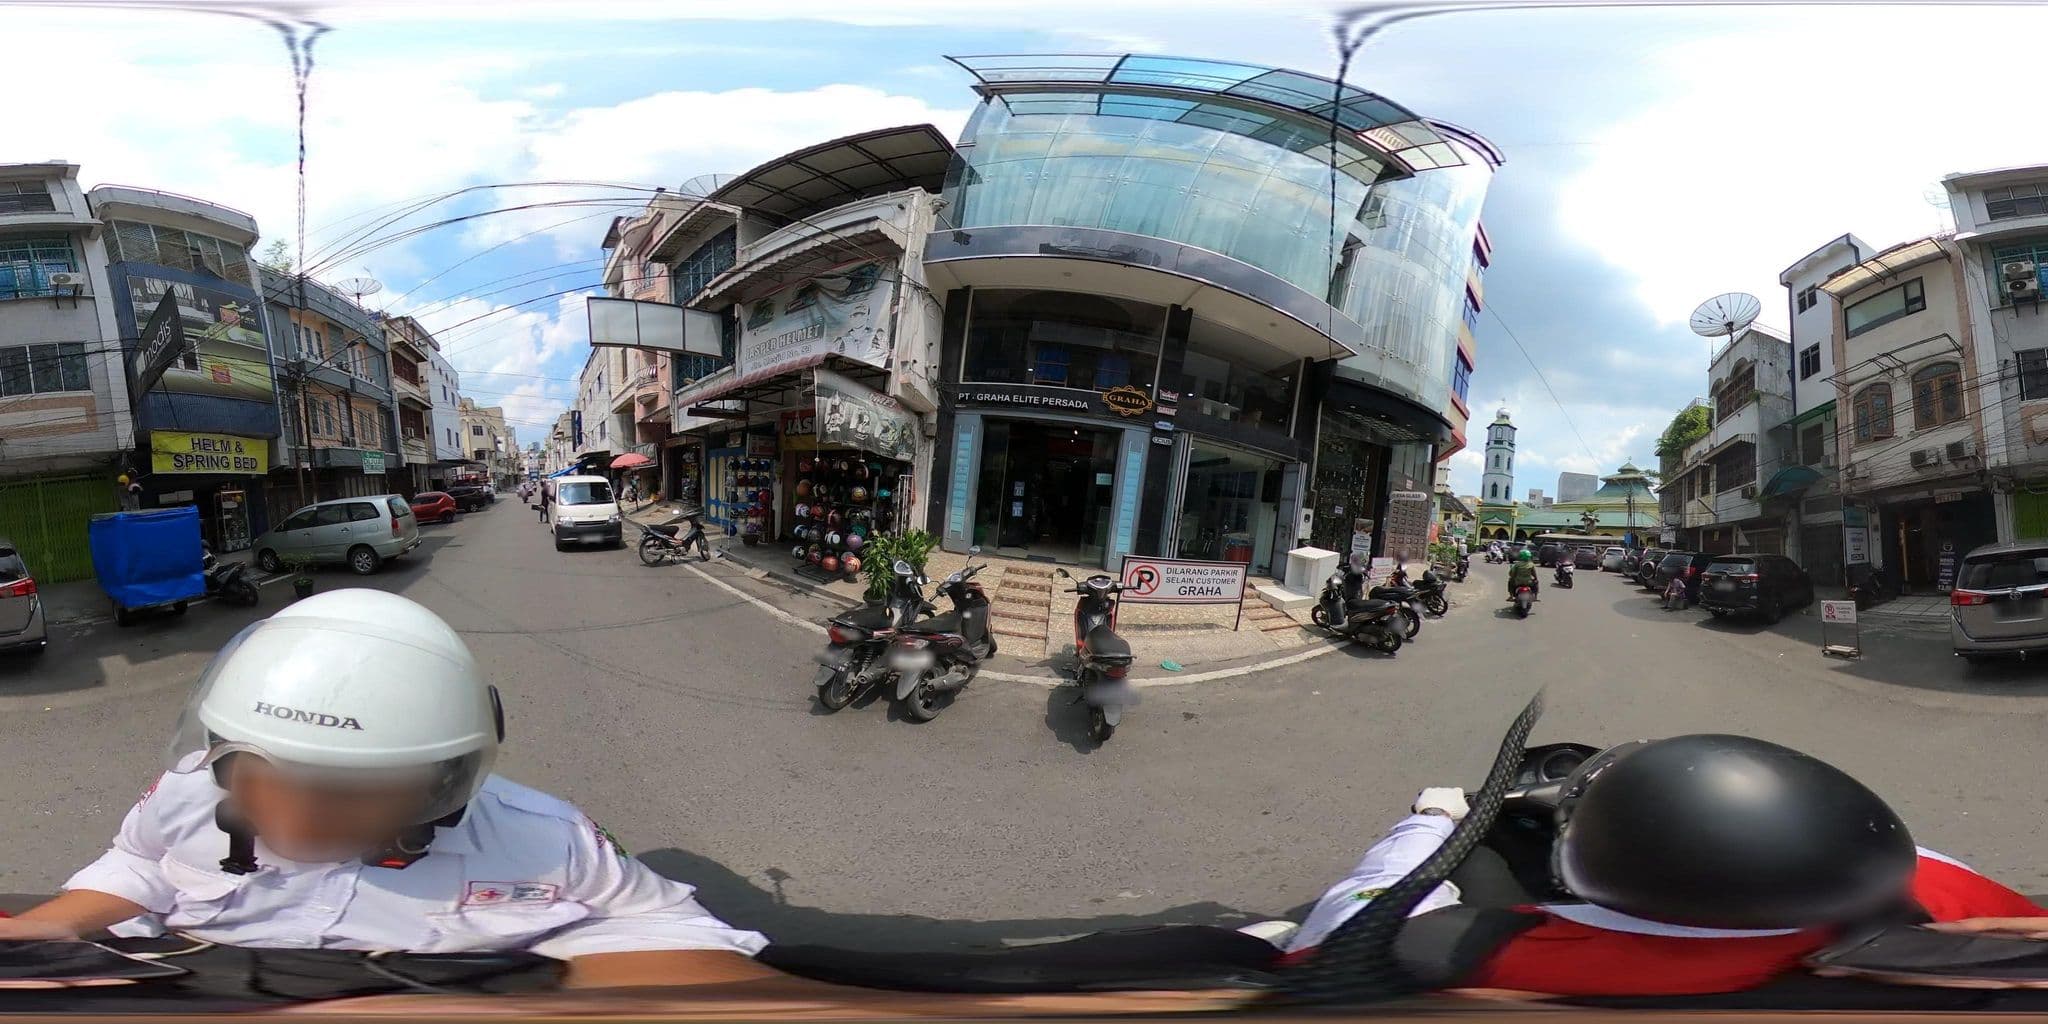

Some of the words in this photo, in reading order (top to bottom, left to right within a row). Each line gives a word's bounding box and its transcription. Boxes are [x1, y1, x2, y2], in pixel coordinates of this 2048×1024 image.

[779, 324, 821, 348] HELMET
[958, 392, 970, 400] PT
[977, 393, 1010, 402] GRAHA
[1012, 394, 1040, 404] ELITE
[1042, 396, 1089, 410] PERSADA
[1108, 394, 1146, 406] GRAHA
[191, 437, 230, 453] HELM
[234, 440, 244, 454] &
[173, 454, 230, 469] SPRING
[233, 456, 258, 470] BED
[1166, 567, 1209, 576] DILARANG
[1210, 568, 1239, 577] PARKIR
[1165, 576, 1194, 584] SELAIN
[1196, 576, 1237, 585] CUSTOMER
[1178, 585, 1222, 596] GRAHA
[254, 701, 364, 731] HONDA
